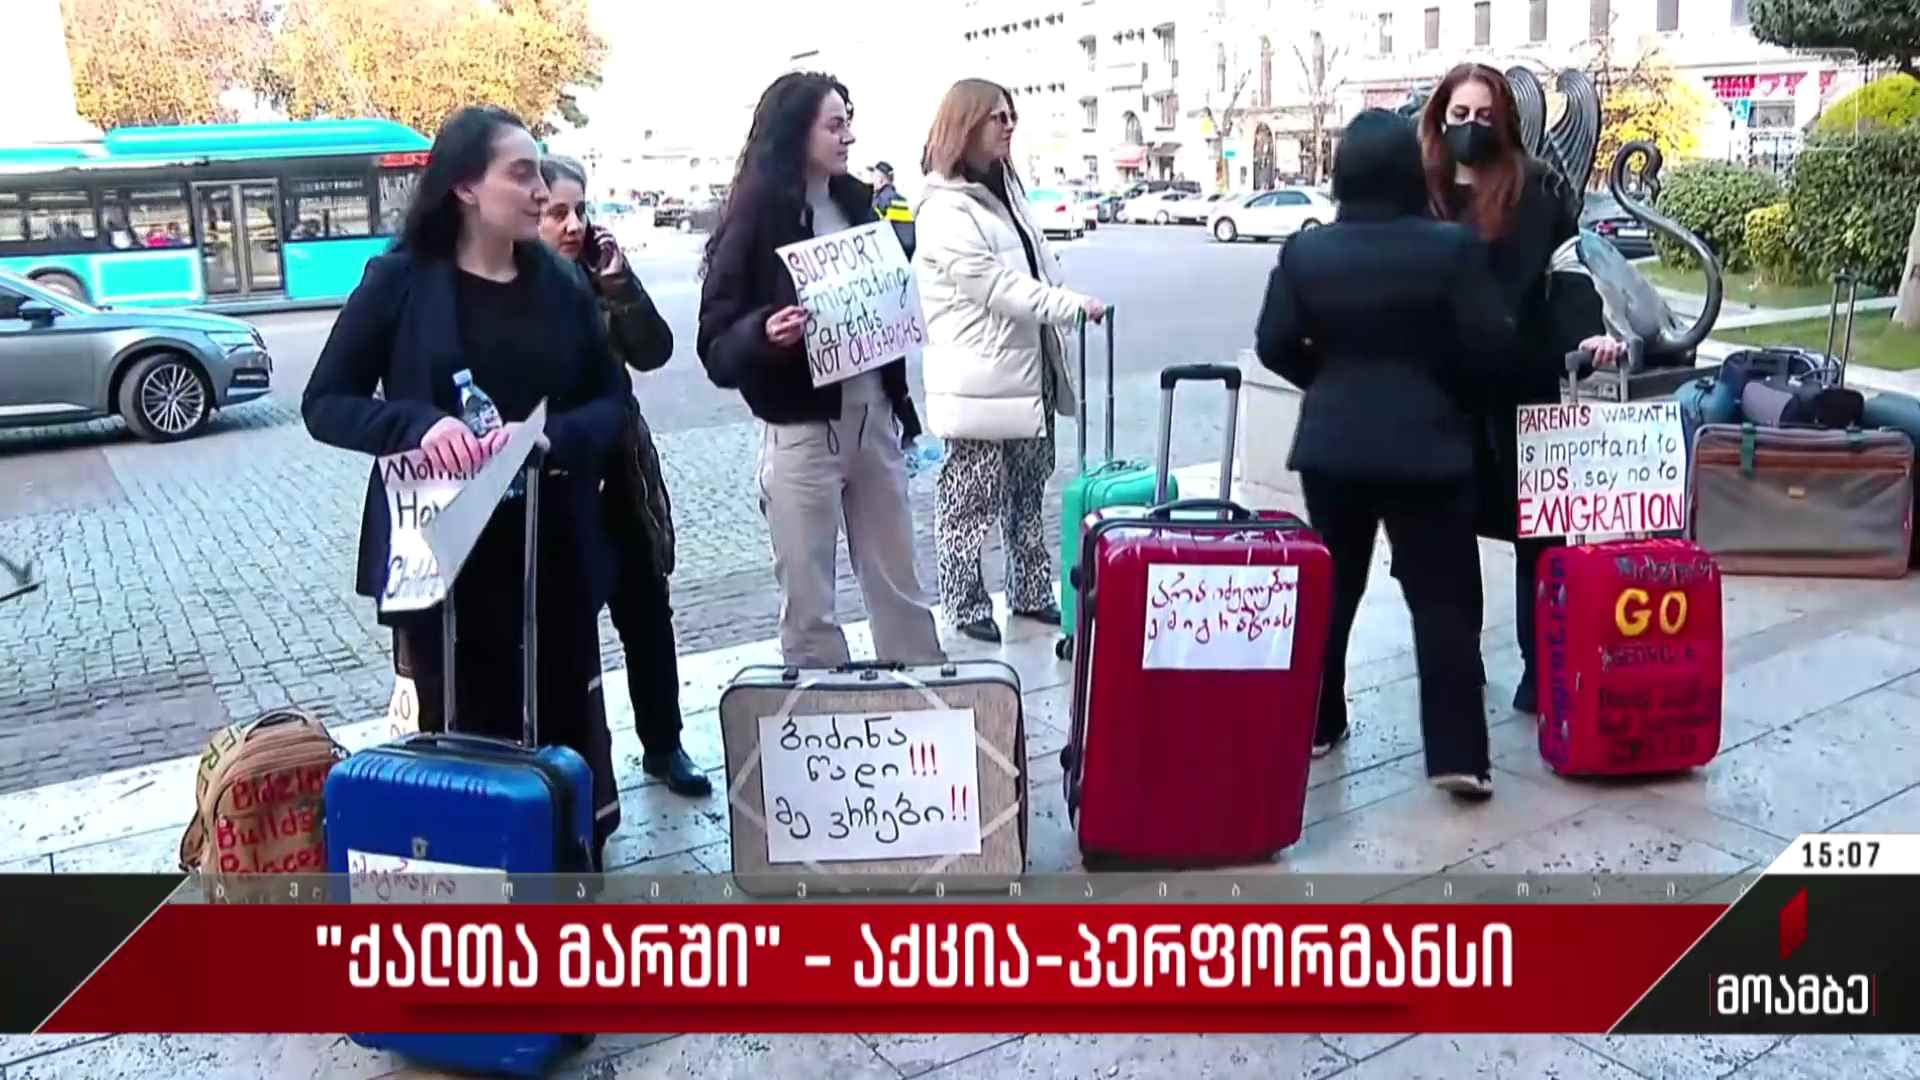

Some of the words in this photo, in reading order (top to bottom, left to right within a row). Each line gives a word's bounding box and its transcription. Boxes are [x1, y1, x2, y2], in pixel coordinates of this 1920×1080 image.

[787, 229, 884, 286] SUPPORT
[804, 303, 883, 348] Parents
[810, 345, 842, 378] NOT
[848, 316, 923, 366] OLIGARCHS
[1518, 404, 1592, 434] PARENTS
[1601, 404, 1678, 424] WARMTH
[1520, 443, 1535, 464] is
[1545, 432, 1647, 465] important
[1657, 432, 1677, 454] to
[1584, 470, 1618, 491] say
[1627, 466, 1650, 482] no
[1658, 461, 1677, 480] to
[1518, 492, 1684, 536] EMIGRATION
[1614, 587, 1688, 636] GO
[780, 716, 908, 750] ბიძინა
[775, 796, 811, 840] მე
